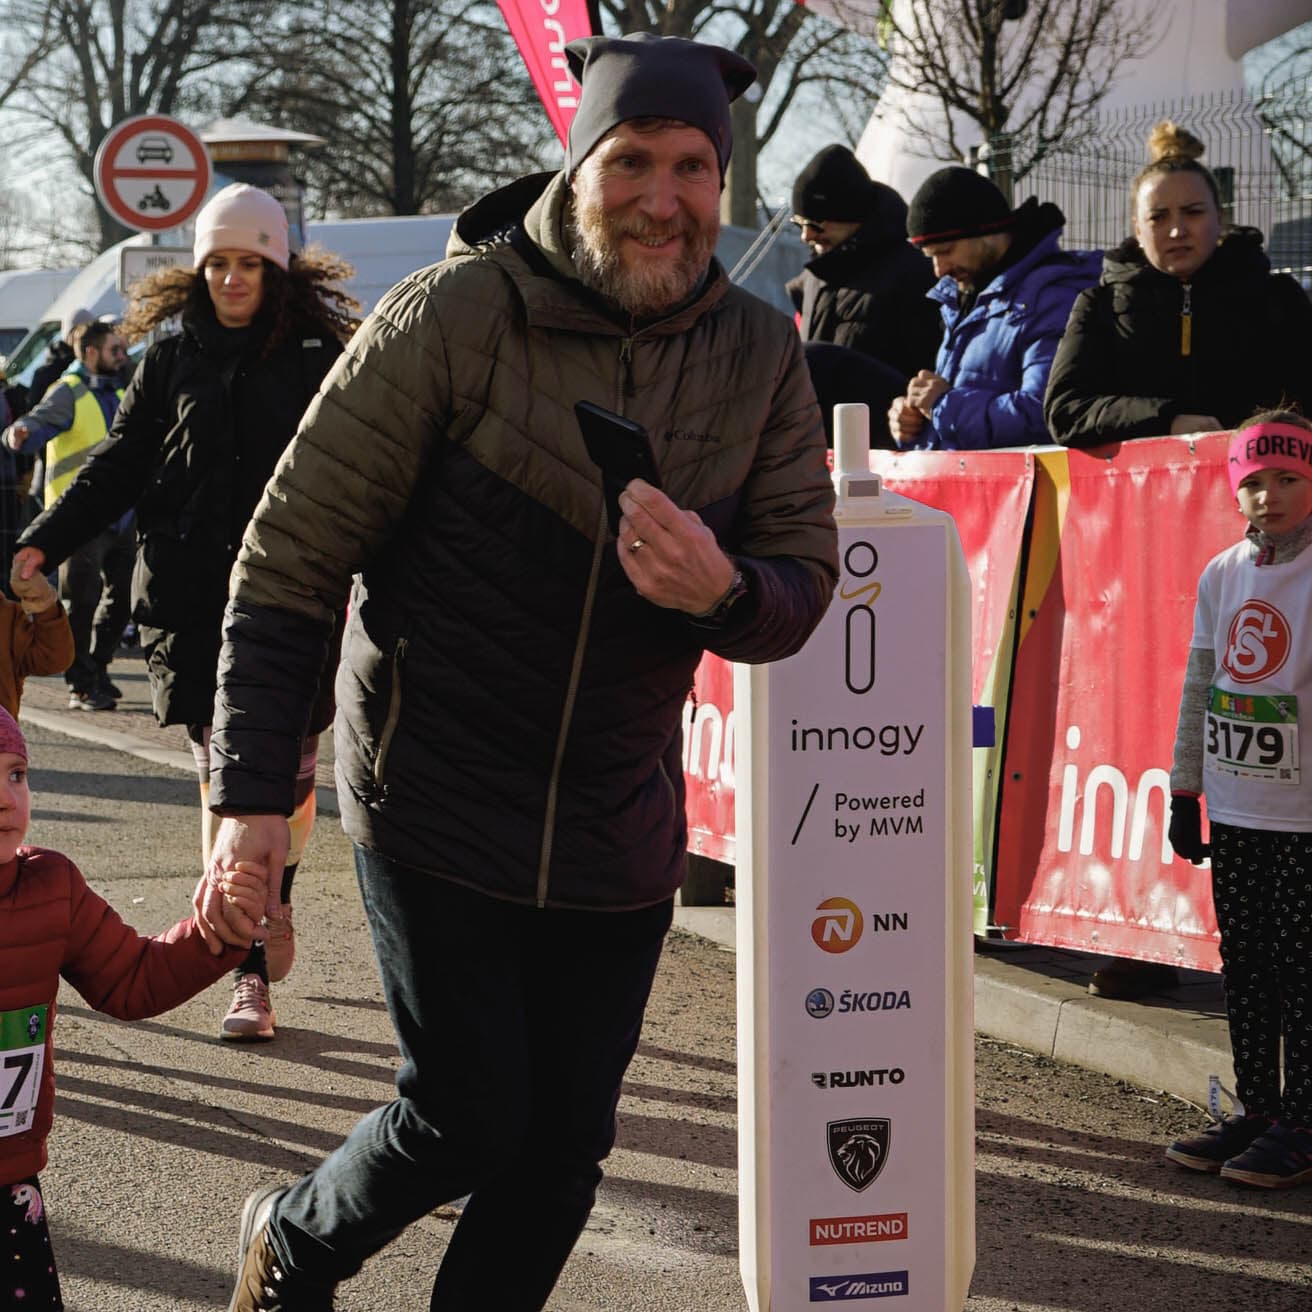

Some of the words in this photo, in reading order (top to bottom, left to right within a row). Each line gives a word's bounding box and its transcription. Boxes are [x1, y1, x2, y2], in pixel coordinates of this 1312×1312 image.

[791, 719, 924, 756] innogy
[1207, 715, 1284, 766] 3179
[834, 789, 925, 811] Powered
[1057, 725, 1212, 870] inn
[834, 818, 860, 843] by
[869, 815, 923, 836] MVM
[872, 912, 908, 932] NN
[837, 989, 911, 1013] ŠKODA
[830, 1067, 905, 1089] RUNTO
[832, 1123, 885, 1134] PEUGEOT
[815, 1219, 904, 1240] NUTREND
